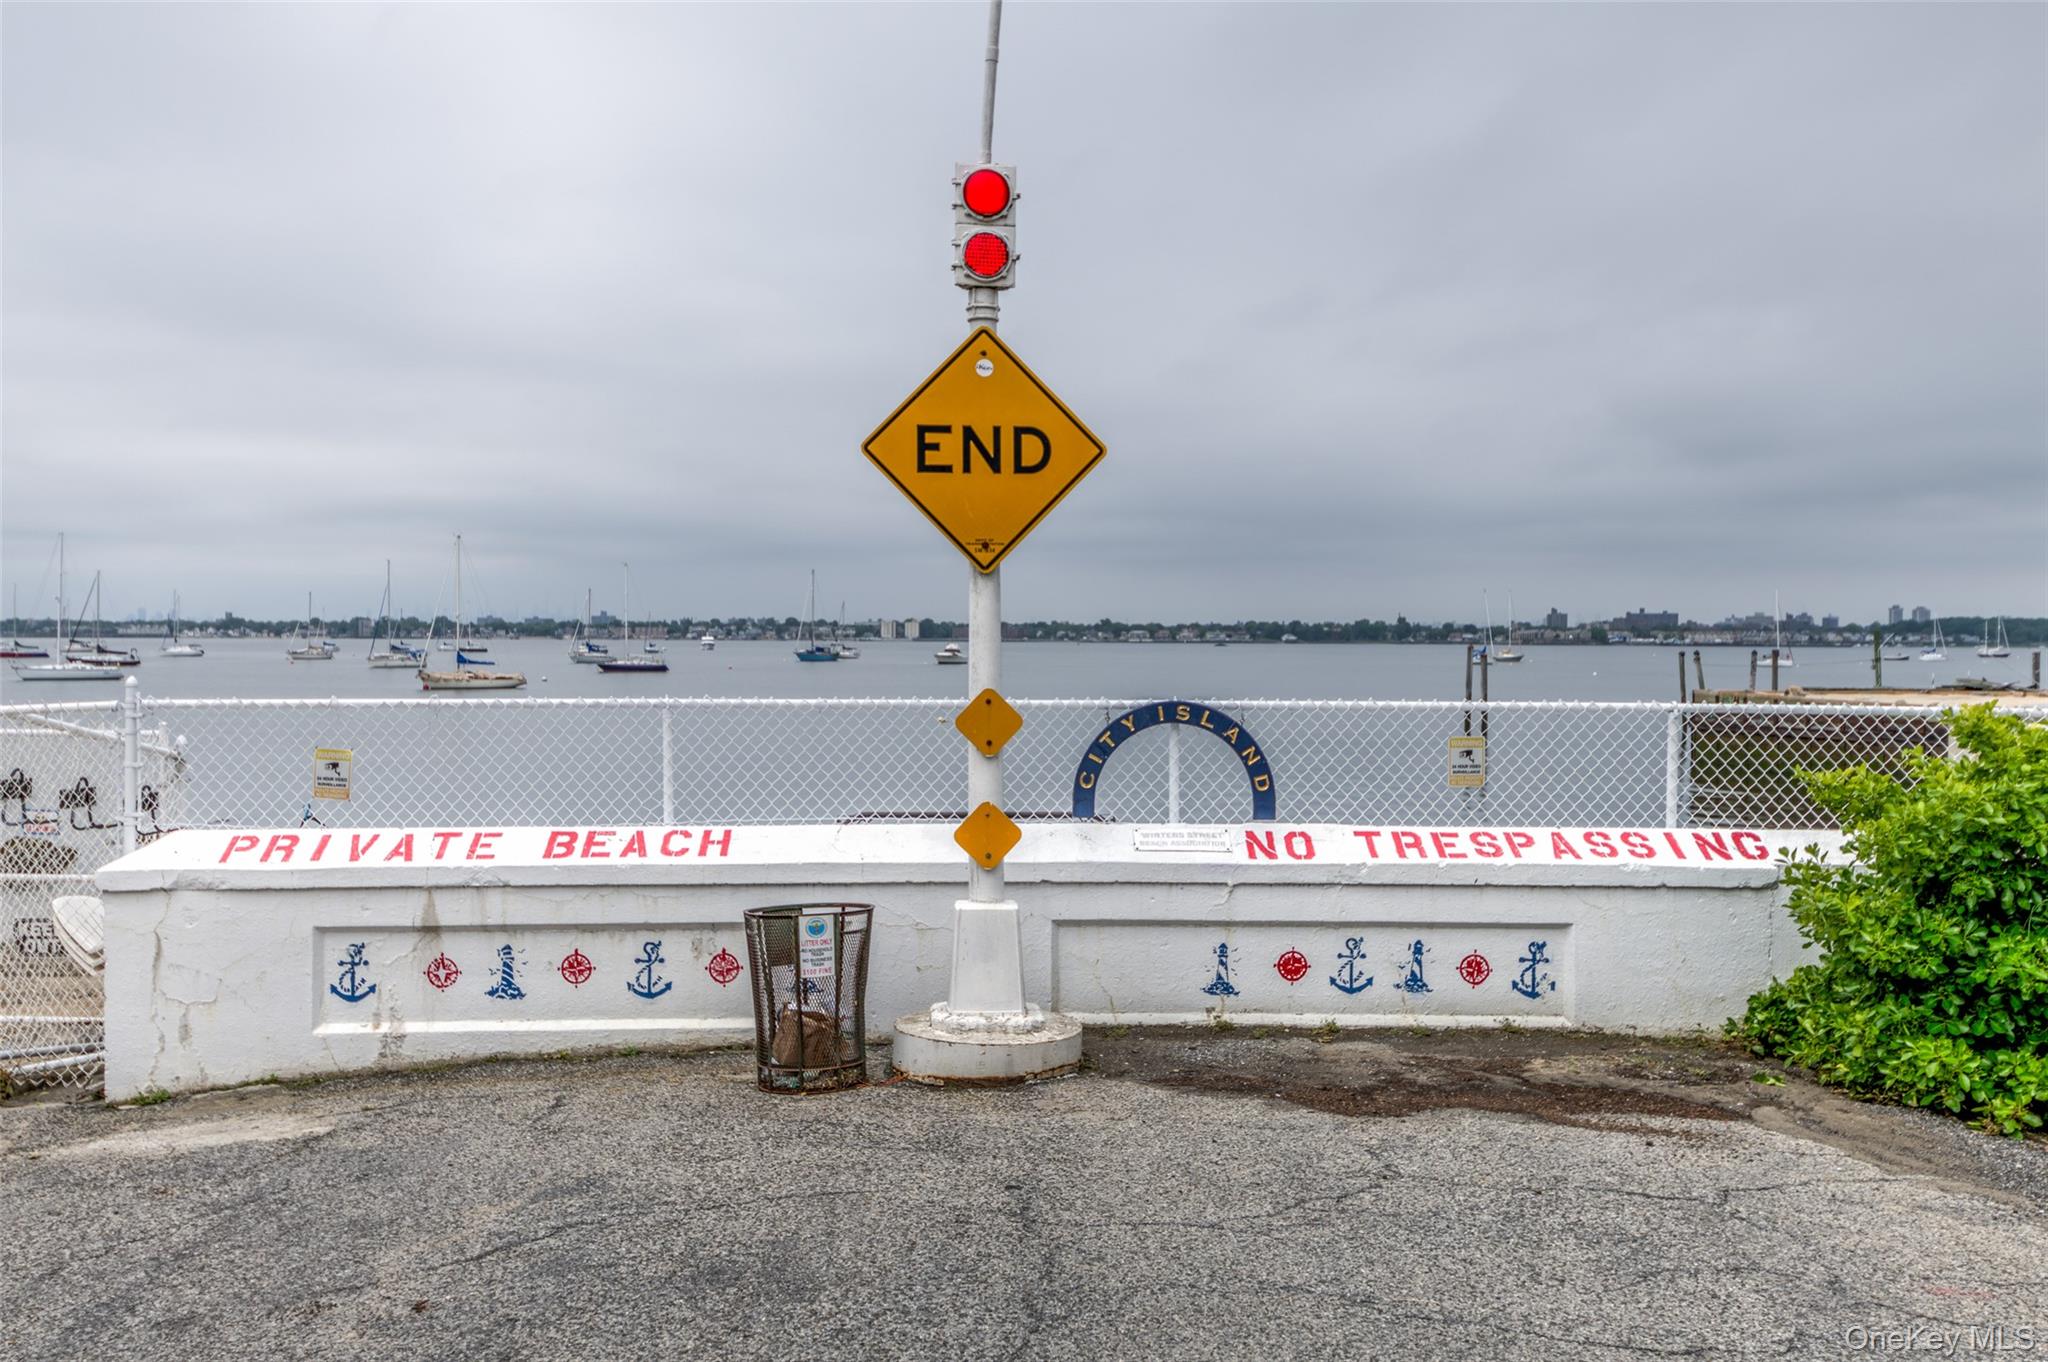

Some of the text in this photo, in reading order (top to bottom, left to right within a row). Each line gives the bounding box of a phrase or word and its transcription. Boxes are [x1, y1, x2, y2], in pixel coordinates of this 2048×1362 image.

[916, 424, 1053, 475] END
[1079, 704, 1271, 792] CITY ISLAND
[218, 829, 732, 864] PRIVATE BEACH
[1187, 831, 1224, 839] STREET
[1245, 830, 1769, 860] NO TRESPASSING
